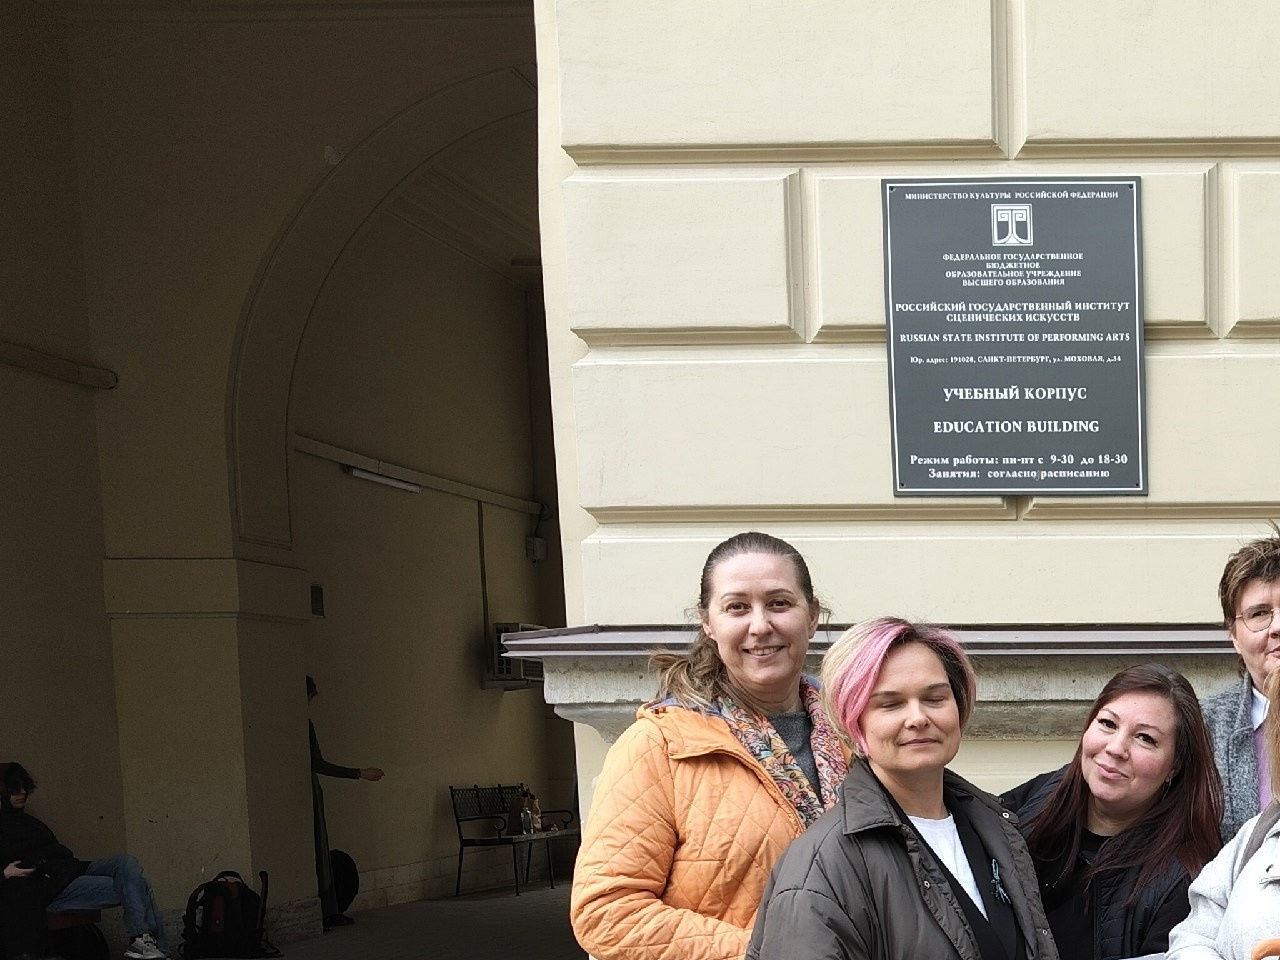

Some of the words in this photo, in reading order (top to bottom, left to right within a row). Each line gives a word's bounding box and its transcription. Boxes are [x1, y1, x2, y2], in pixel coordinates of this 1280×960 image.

[905, 191, 968, 200] МИНИСТЕРСТВО
[970, 191, 1011, 200] КУЛЬТУРЫ
[1015, 190, 1068, 199] РОССИЙСКОЙ
[1070, 191, 1118, 200] ФЕДЕРАЦИИ
[942, 253, 1001, 261] ФЕДЕРАЛЬНОЕ
[1003, 253, 1083, 261] ГОСУДАРСТВЕННОЕ
[945, 270, 1025, 278] ОБРАЗОВАТЕЛЬНОЕ
[1026, 270, 1081, 278] УЧРЕЖДЕНИЕ
[895, 301, 966, 312] РОССИЙСКИЙ
[969, 301, 1072, 312] ГОСУДАРСТВЕННЫЙ
[1075, 301, 1129, 310] ИНСТИТУТ
[946, 313, 1023, 323] СЦЕНИЧЕСКИХ
[1025, 313, 1080, 323] ИСКУССТВ
[900, 333, 940, 342] RUSSIAN
[942, 333, 972, 342] STATE
[975, 333, 1025, 342] INSTITUTE
[1028, 333, 1039, 342] OF
[1042, 333, 1103, 342] PERFORMING
[1106, 333, 1130, 342] ARTS
[910, 356, 925, 364] Юр.
[926, 356, 948, 364] адрес:
[950, 356, 976, 364] 191028,
[978, 356, 1051, 364] САНКТ-ПЕТЕРБУРГ,
[1053, 356, 1063, 364] ул.
[1064, 356, 1105, 364] МОХОВАЯ,
[943, 385, 1020, 401] УЧЕБНЫЙ
[1025, 387, 1087, 401] КОРПУС
[933, 421, 1022, 432] EDUCATION
[1027, 421, 1099, 432] BUILDING
[910, 455, 949, 465] Режим
[953, 455, 998, 467] работы:
[1003, 456, 1034, 464] пн-пт
[1038, 456, 1043, 464] с
[1050, 455, 1074, 464] 9-30
[1081, 456, 1094, 465] до
[1098, 455, 1128, 464] 18-30
[928, 469, 980, 478] Занятия:
[987, 470, 1037, 478] согласно
[1040, 470, 1110, 480] расписанию
